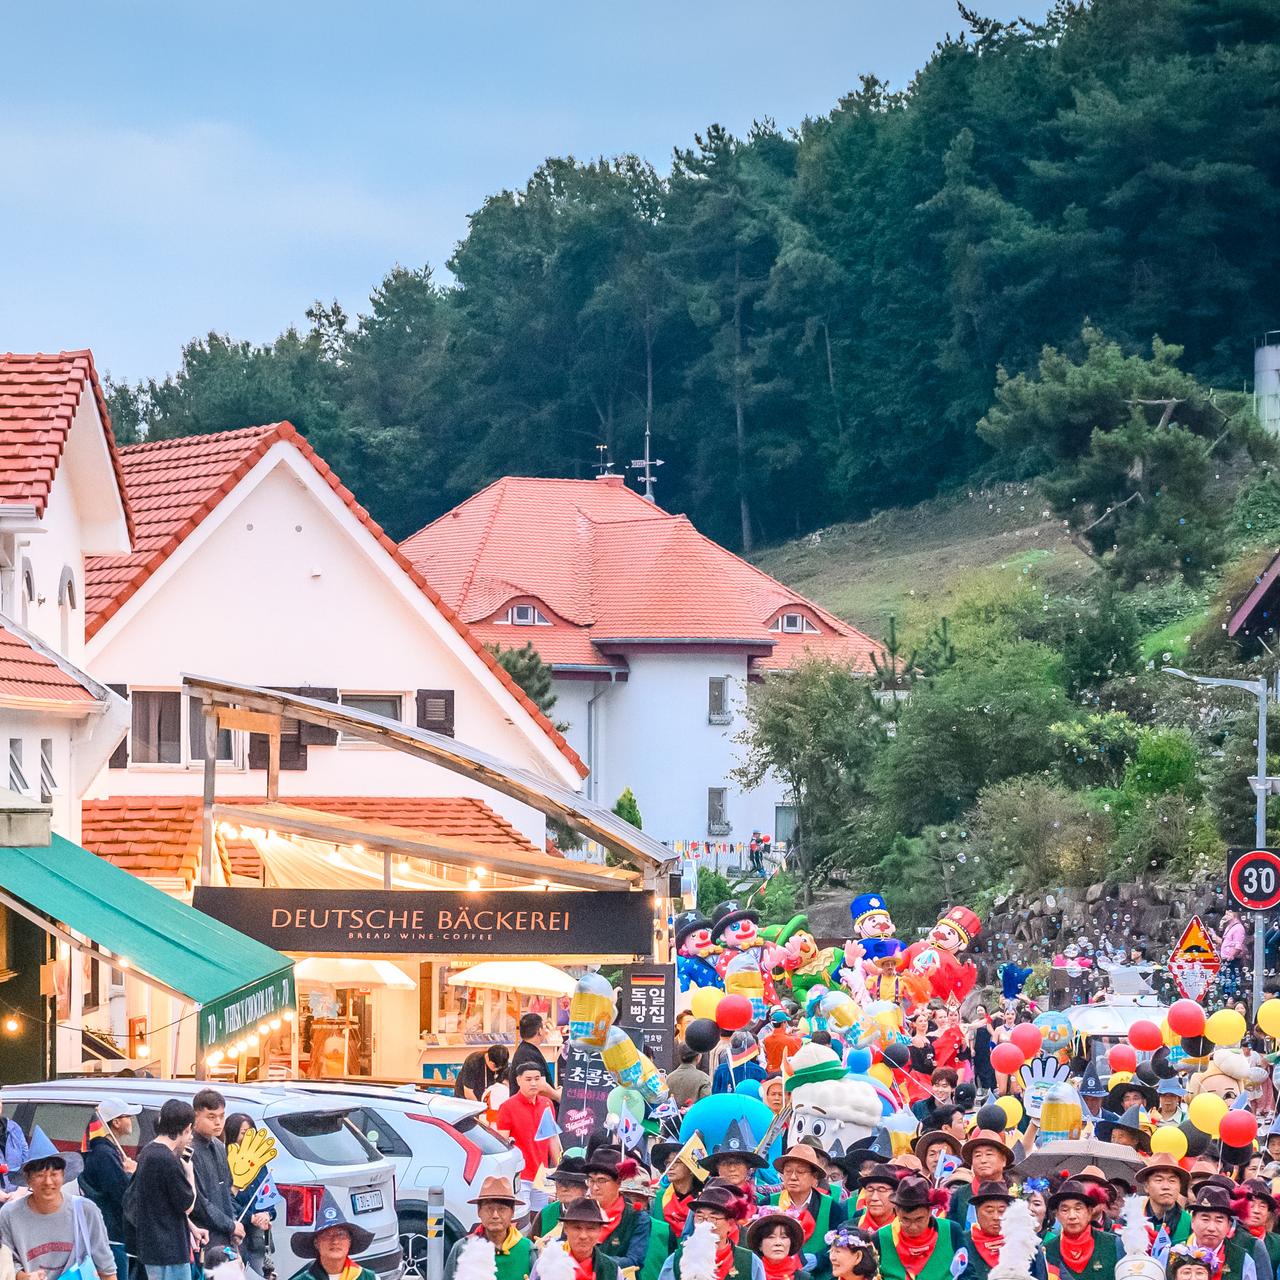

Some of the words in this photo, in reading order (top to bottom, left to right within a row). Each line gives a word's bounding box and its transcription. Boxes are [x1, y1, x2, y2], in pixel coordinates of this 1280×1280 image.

[1243, 867, 1276, 894] 30
[270, 908, 425, 930] DEUTSCHE
[437, 906, 570, 932] BÄCKEREI
[348, 932, 391, 941] BREAD
[400, 932, 435, 941] WINE
[443, 933, 494, 941] COFFEE
[630, 987, 666, 1005] 독일
[630, 1006, 666, 1024] 빵집
